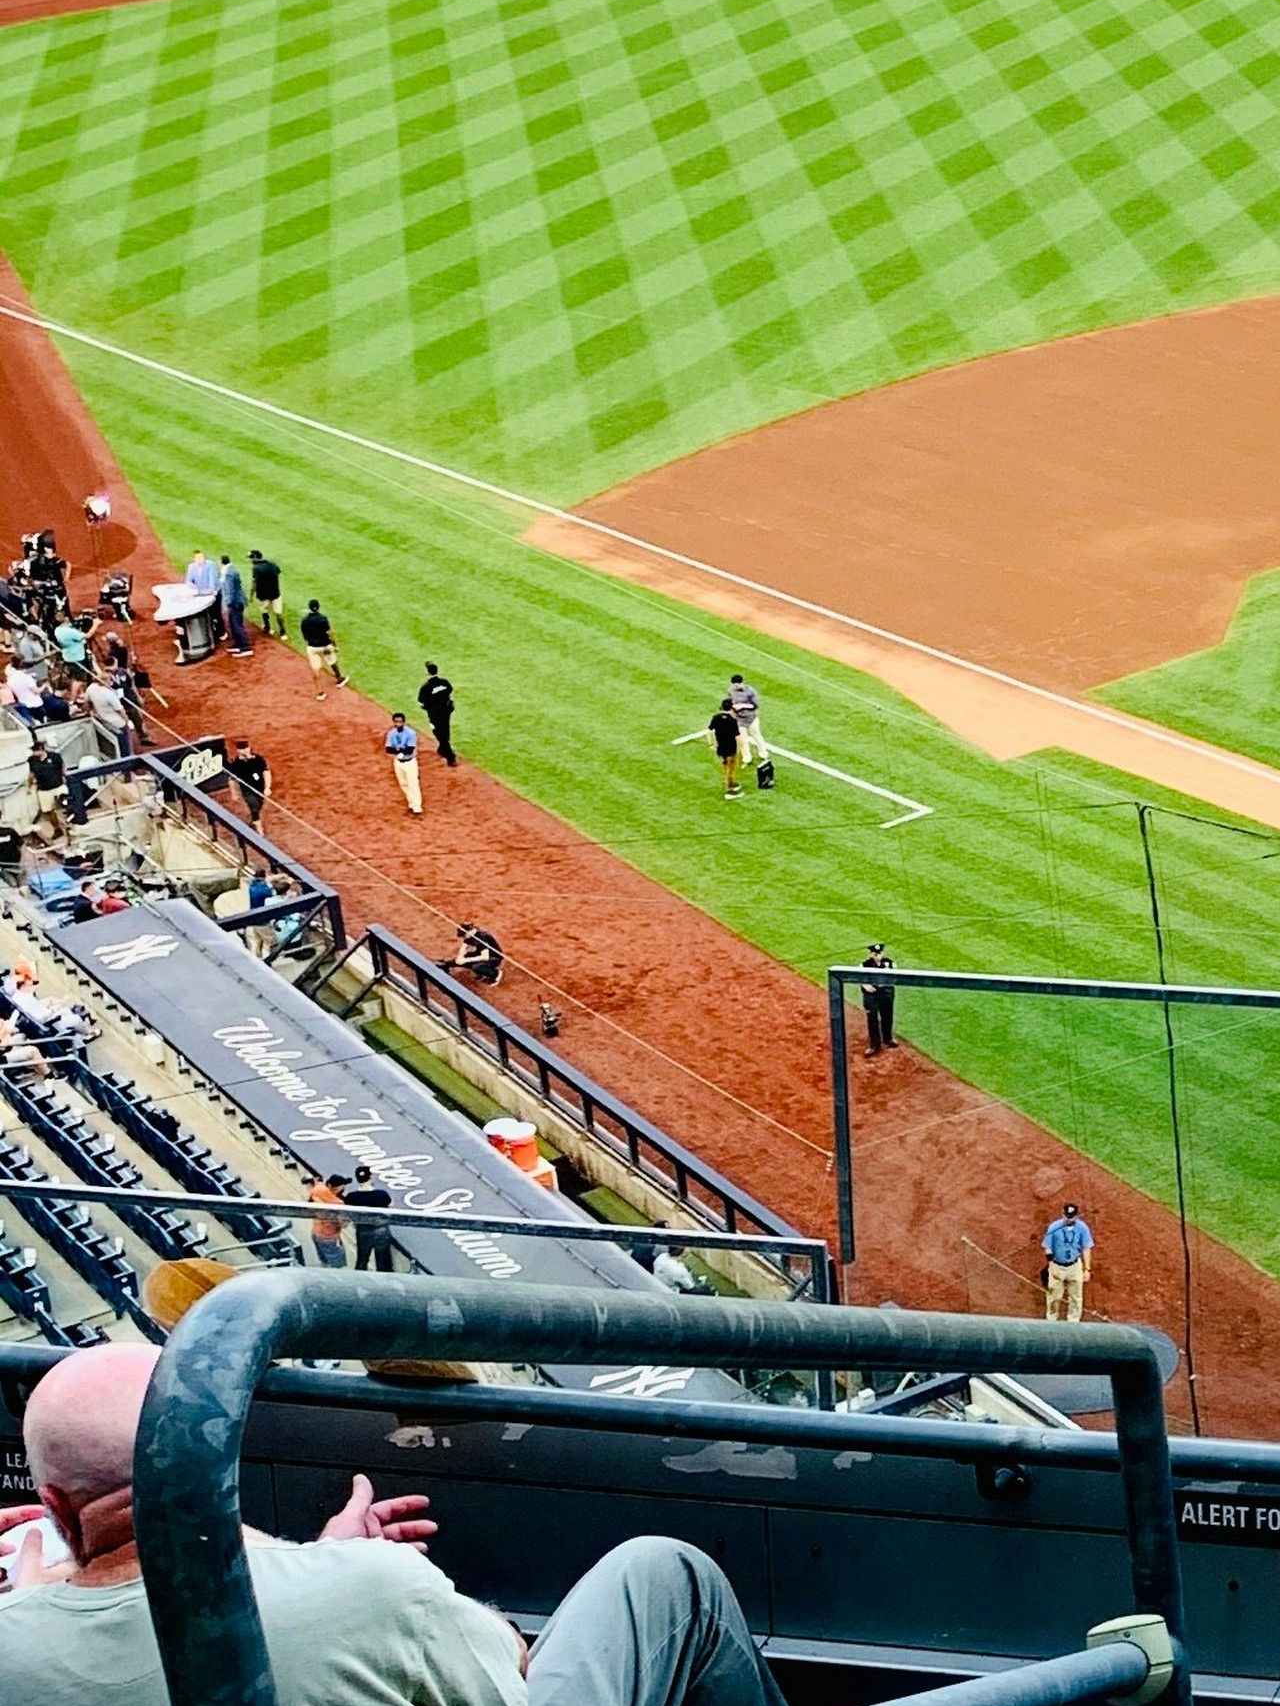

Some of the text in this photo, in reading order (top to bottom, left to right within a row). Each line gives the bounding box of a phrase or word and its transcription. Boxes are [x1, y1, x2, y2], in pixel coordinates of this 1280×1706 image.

[212, 1016, 434, 1191] Welcome to Yankee
[1181, 1501, 1250, 1528] ALERT
